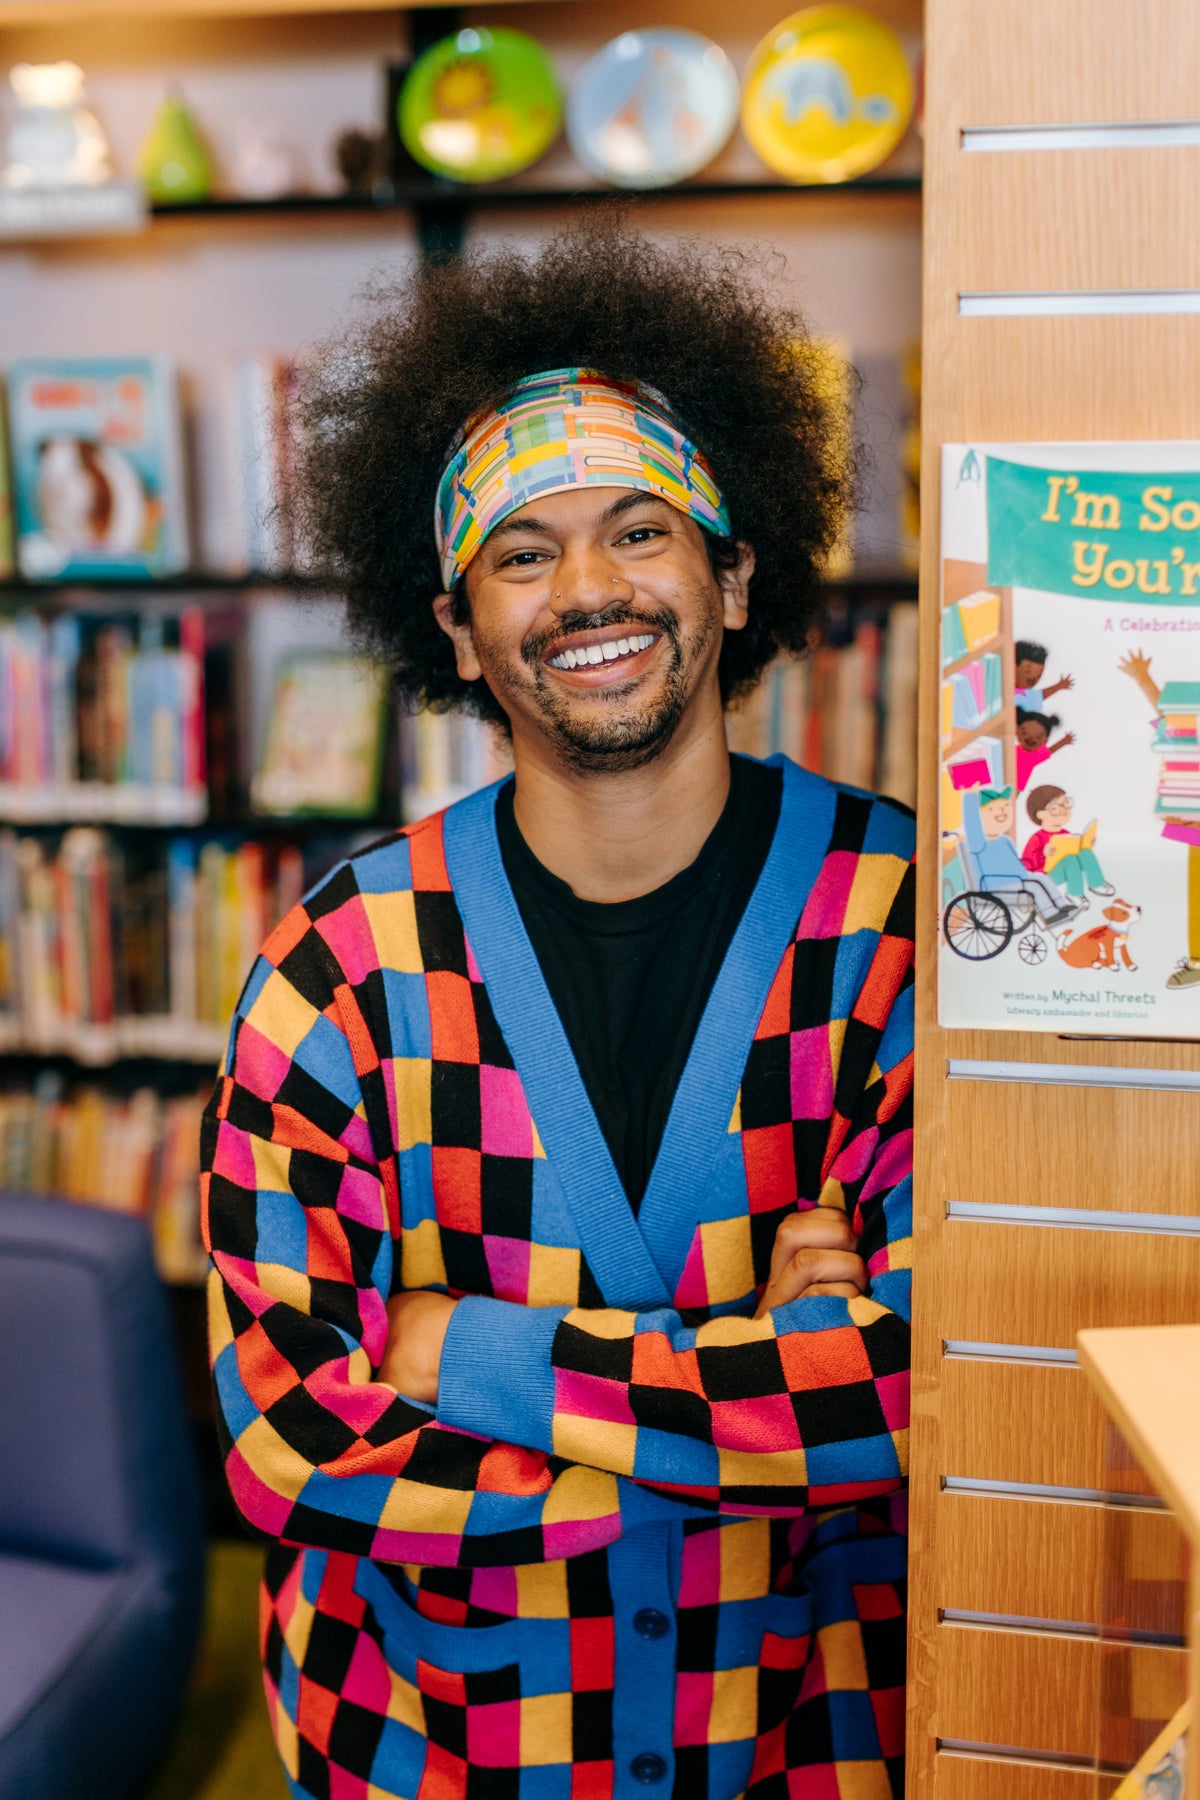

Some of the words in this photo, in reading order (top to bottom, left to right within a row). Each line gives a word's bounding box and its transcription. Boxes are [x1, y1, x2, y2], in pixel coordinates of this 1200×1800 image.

[1041, 475, 1121, 530] I'm
[1139, 485, 1200, 532] So
[1071, 541, 1200, 595] You'r
[1103, 618, 1114, 632] A
[1119, 617, 1200, 632] Celebratio
[1037, 993, 1048, 1002] by
[1052, 989, 1100, 1004] Mychal
[1104, 990, 1156, 1004] Threets
[1095, 1009, 1110, 1018] and
